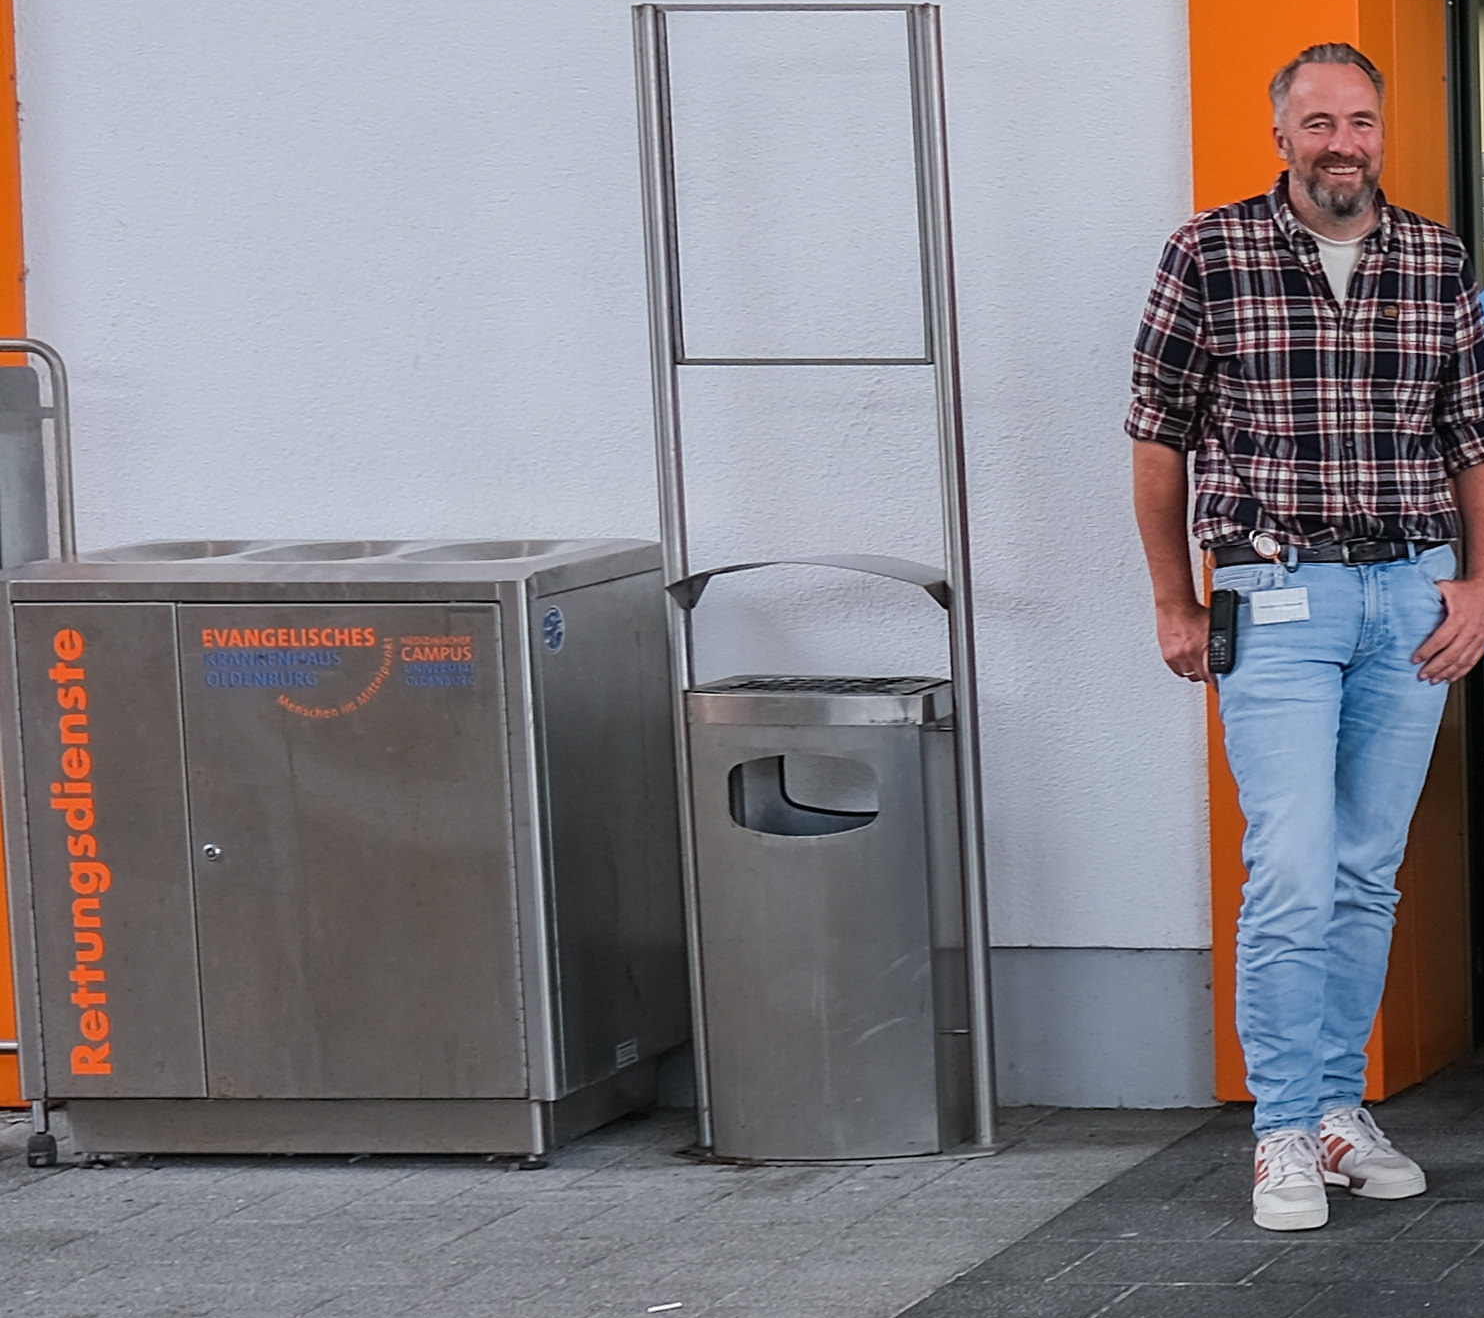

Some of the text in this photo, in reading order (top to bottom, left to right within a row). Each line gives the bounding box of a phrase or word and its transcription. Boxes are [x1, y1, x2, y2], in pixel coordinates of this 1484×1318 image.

[202, 627, 376, 648] EVANGELISCHES
[203, 650, 342, 667] KRANKENHAUS
[401, 646, 473, 662] CAMPUS
[204, 670, 319, 688] OLDENBURG
[276, 637, 394, 718] Menschen im Mittelpunkt
[49, 627, 112, 1075] Rettungsdienste
